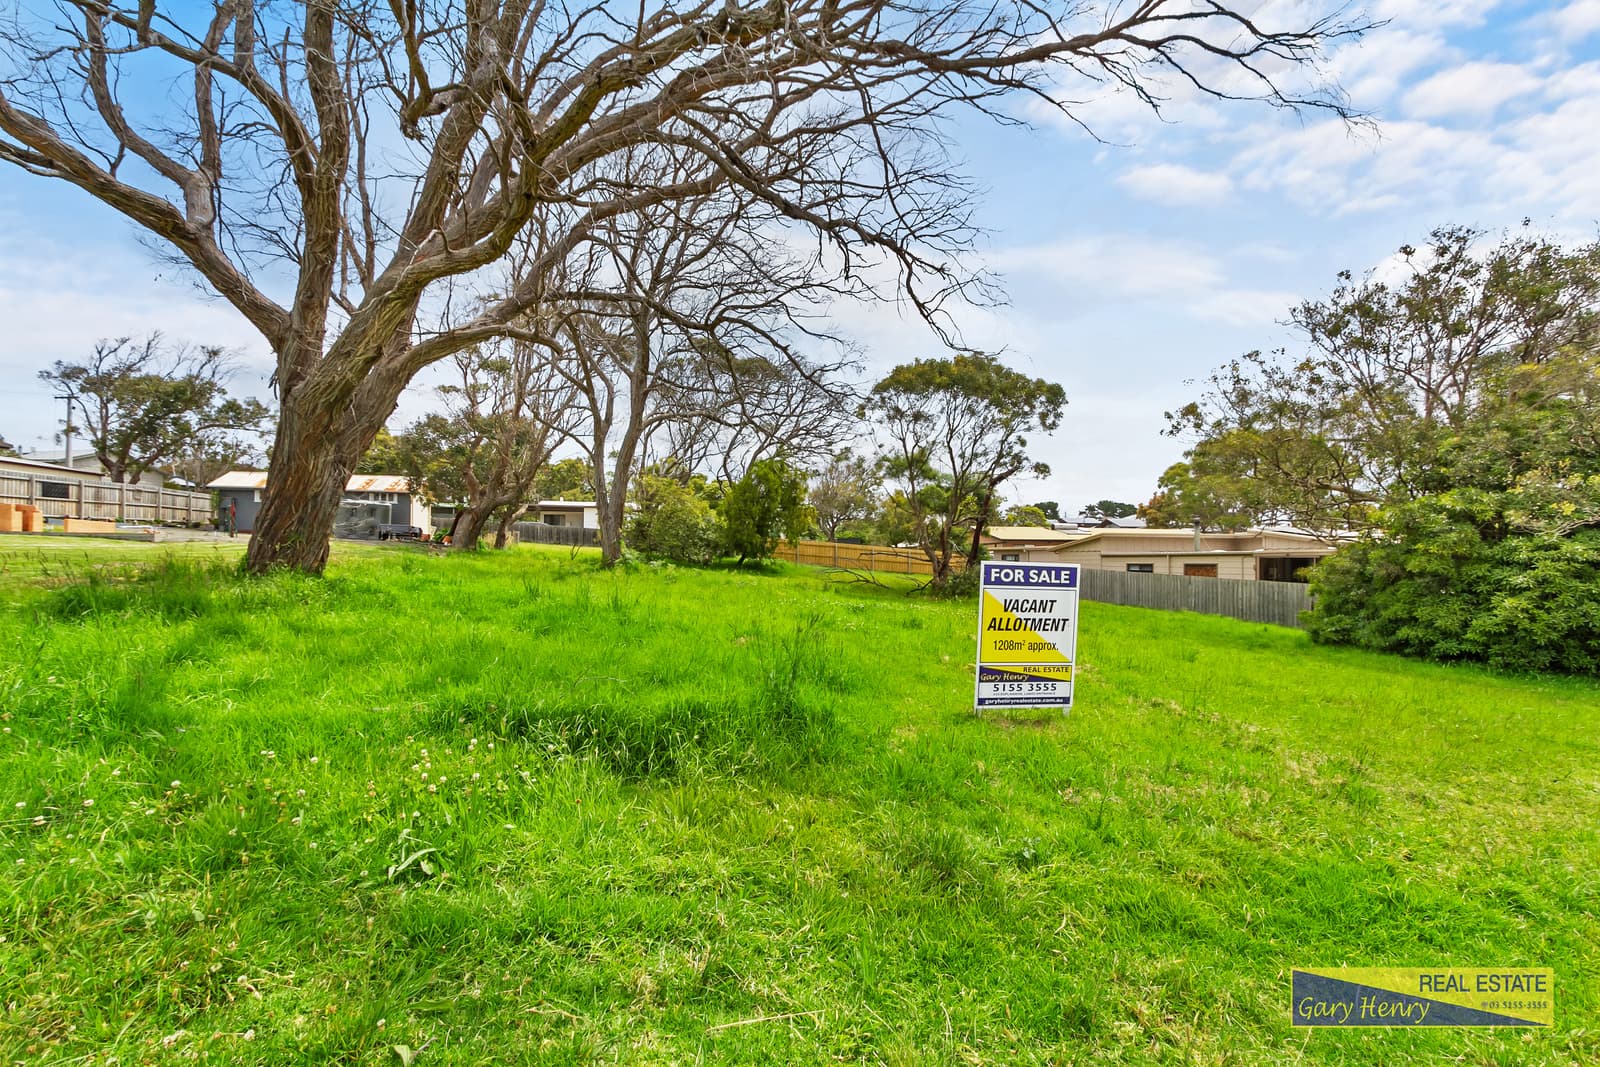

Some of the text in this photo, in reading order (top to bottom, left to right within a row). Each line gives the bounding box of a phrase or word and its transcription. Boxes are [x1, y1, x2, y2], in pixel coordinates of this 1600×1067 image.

[991, 568, 1070, 584] FOR SALE
[1003, 598, 1057, 613] VACANT
[987, 617, 1069, 632] ALLOTMENT
[1027, 641, 1059, 653] approx.
[980, 672, 1030, 682] Gary Henry
[993, 682, 1057, 692] 5155 3555
